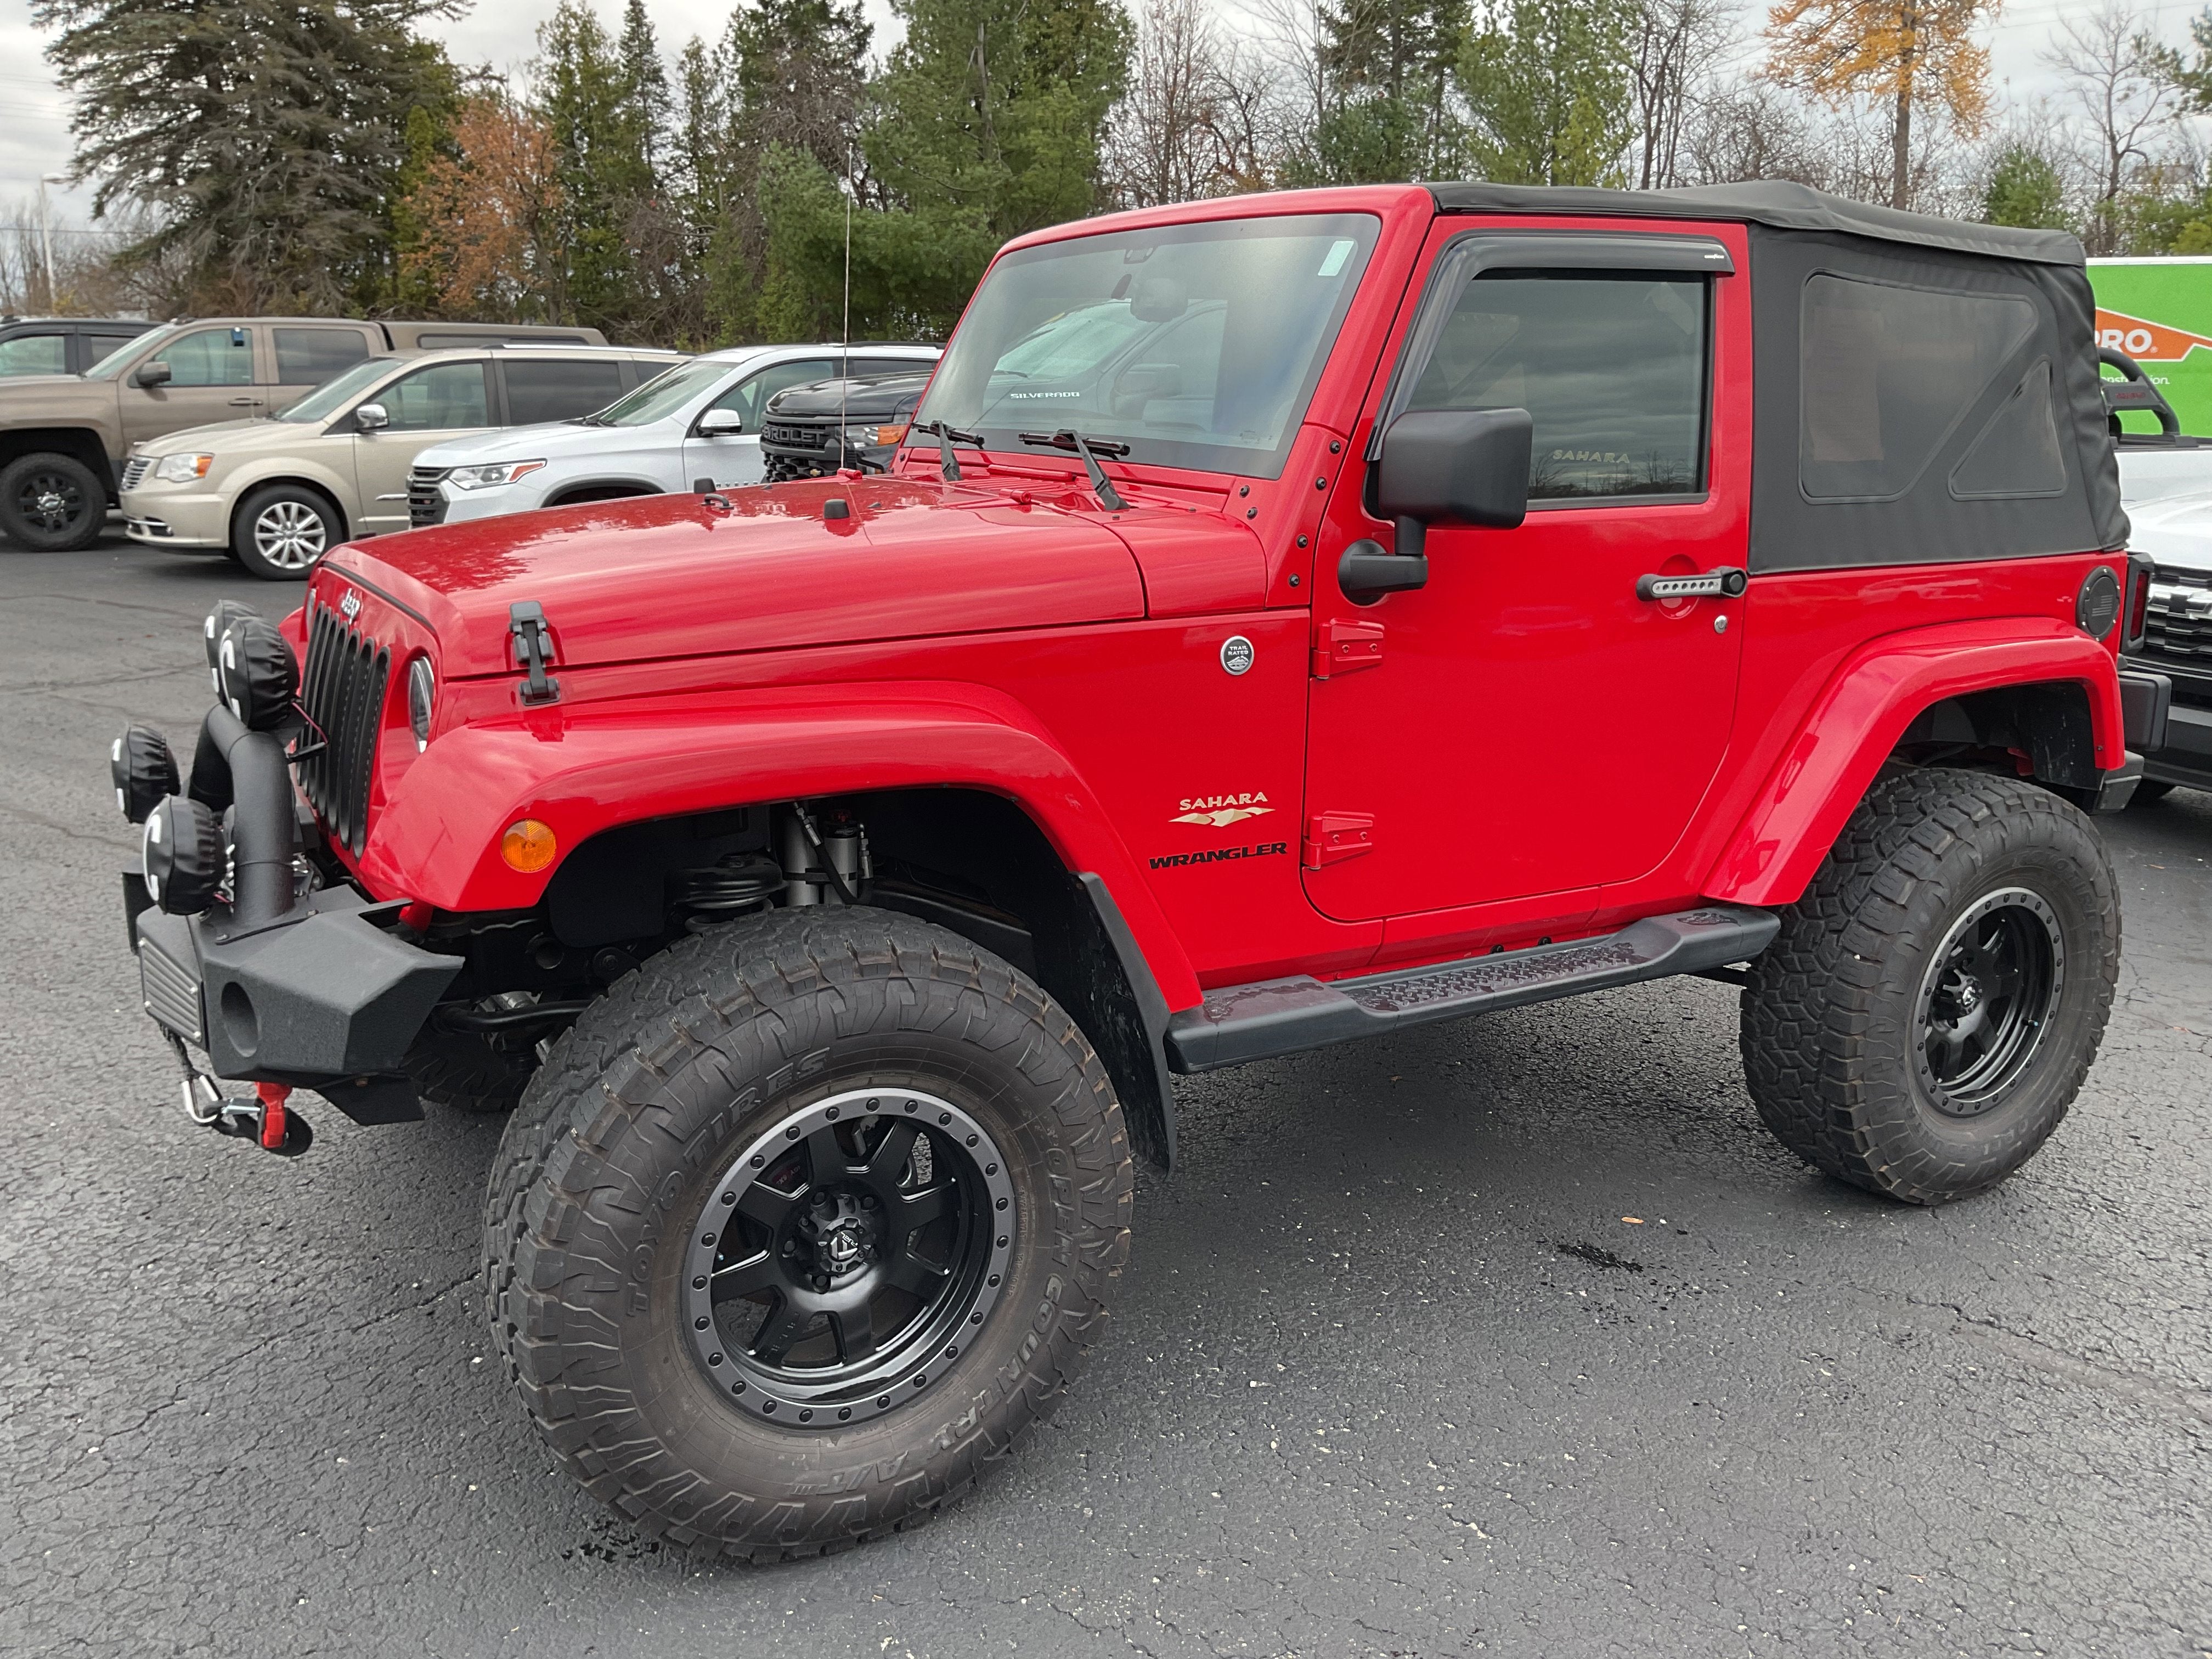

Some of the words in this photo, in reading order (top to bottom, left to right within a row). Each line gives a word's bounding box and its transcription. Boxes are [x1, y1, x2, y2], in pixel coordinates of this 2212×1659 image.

[1552, 449, 1630, 464] SAHARA
[1179, 791, 1268, 811] SAHARA
[1148, 842, 1288, 870] WRANGLER
[626, 1170, 686, 1318] TOYO
[683, 1047, 831, 1169] TIRES
[1045, 1147, 1075, 1268] OPEN
[840, 1232, 858, 1248] FUEL
[929, 1272, 1066, 1459] COUNTRY
